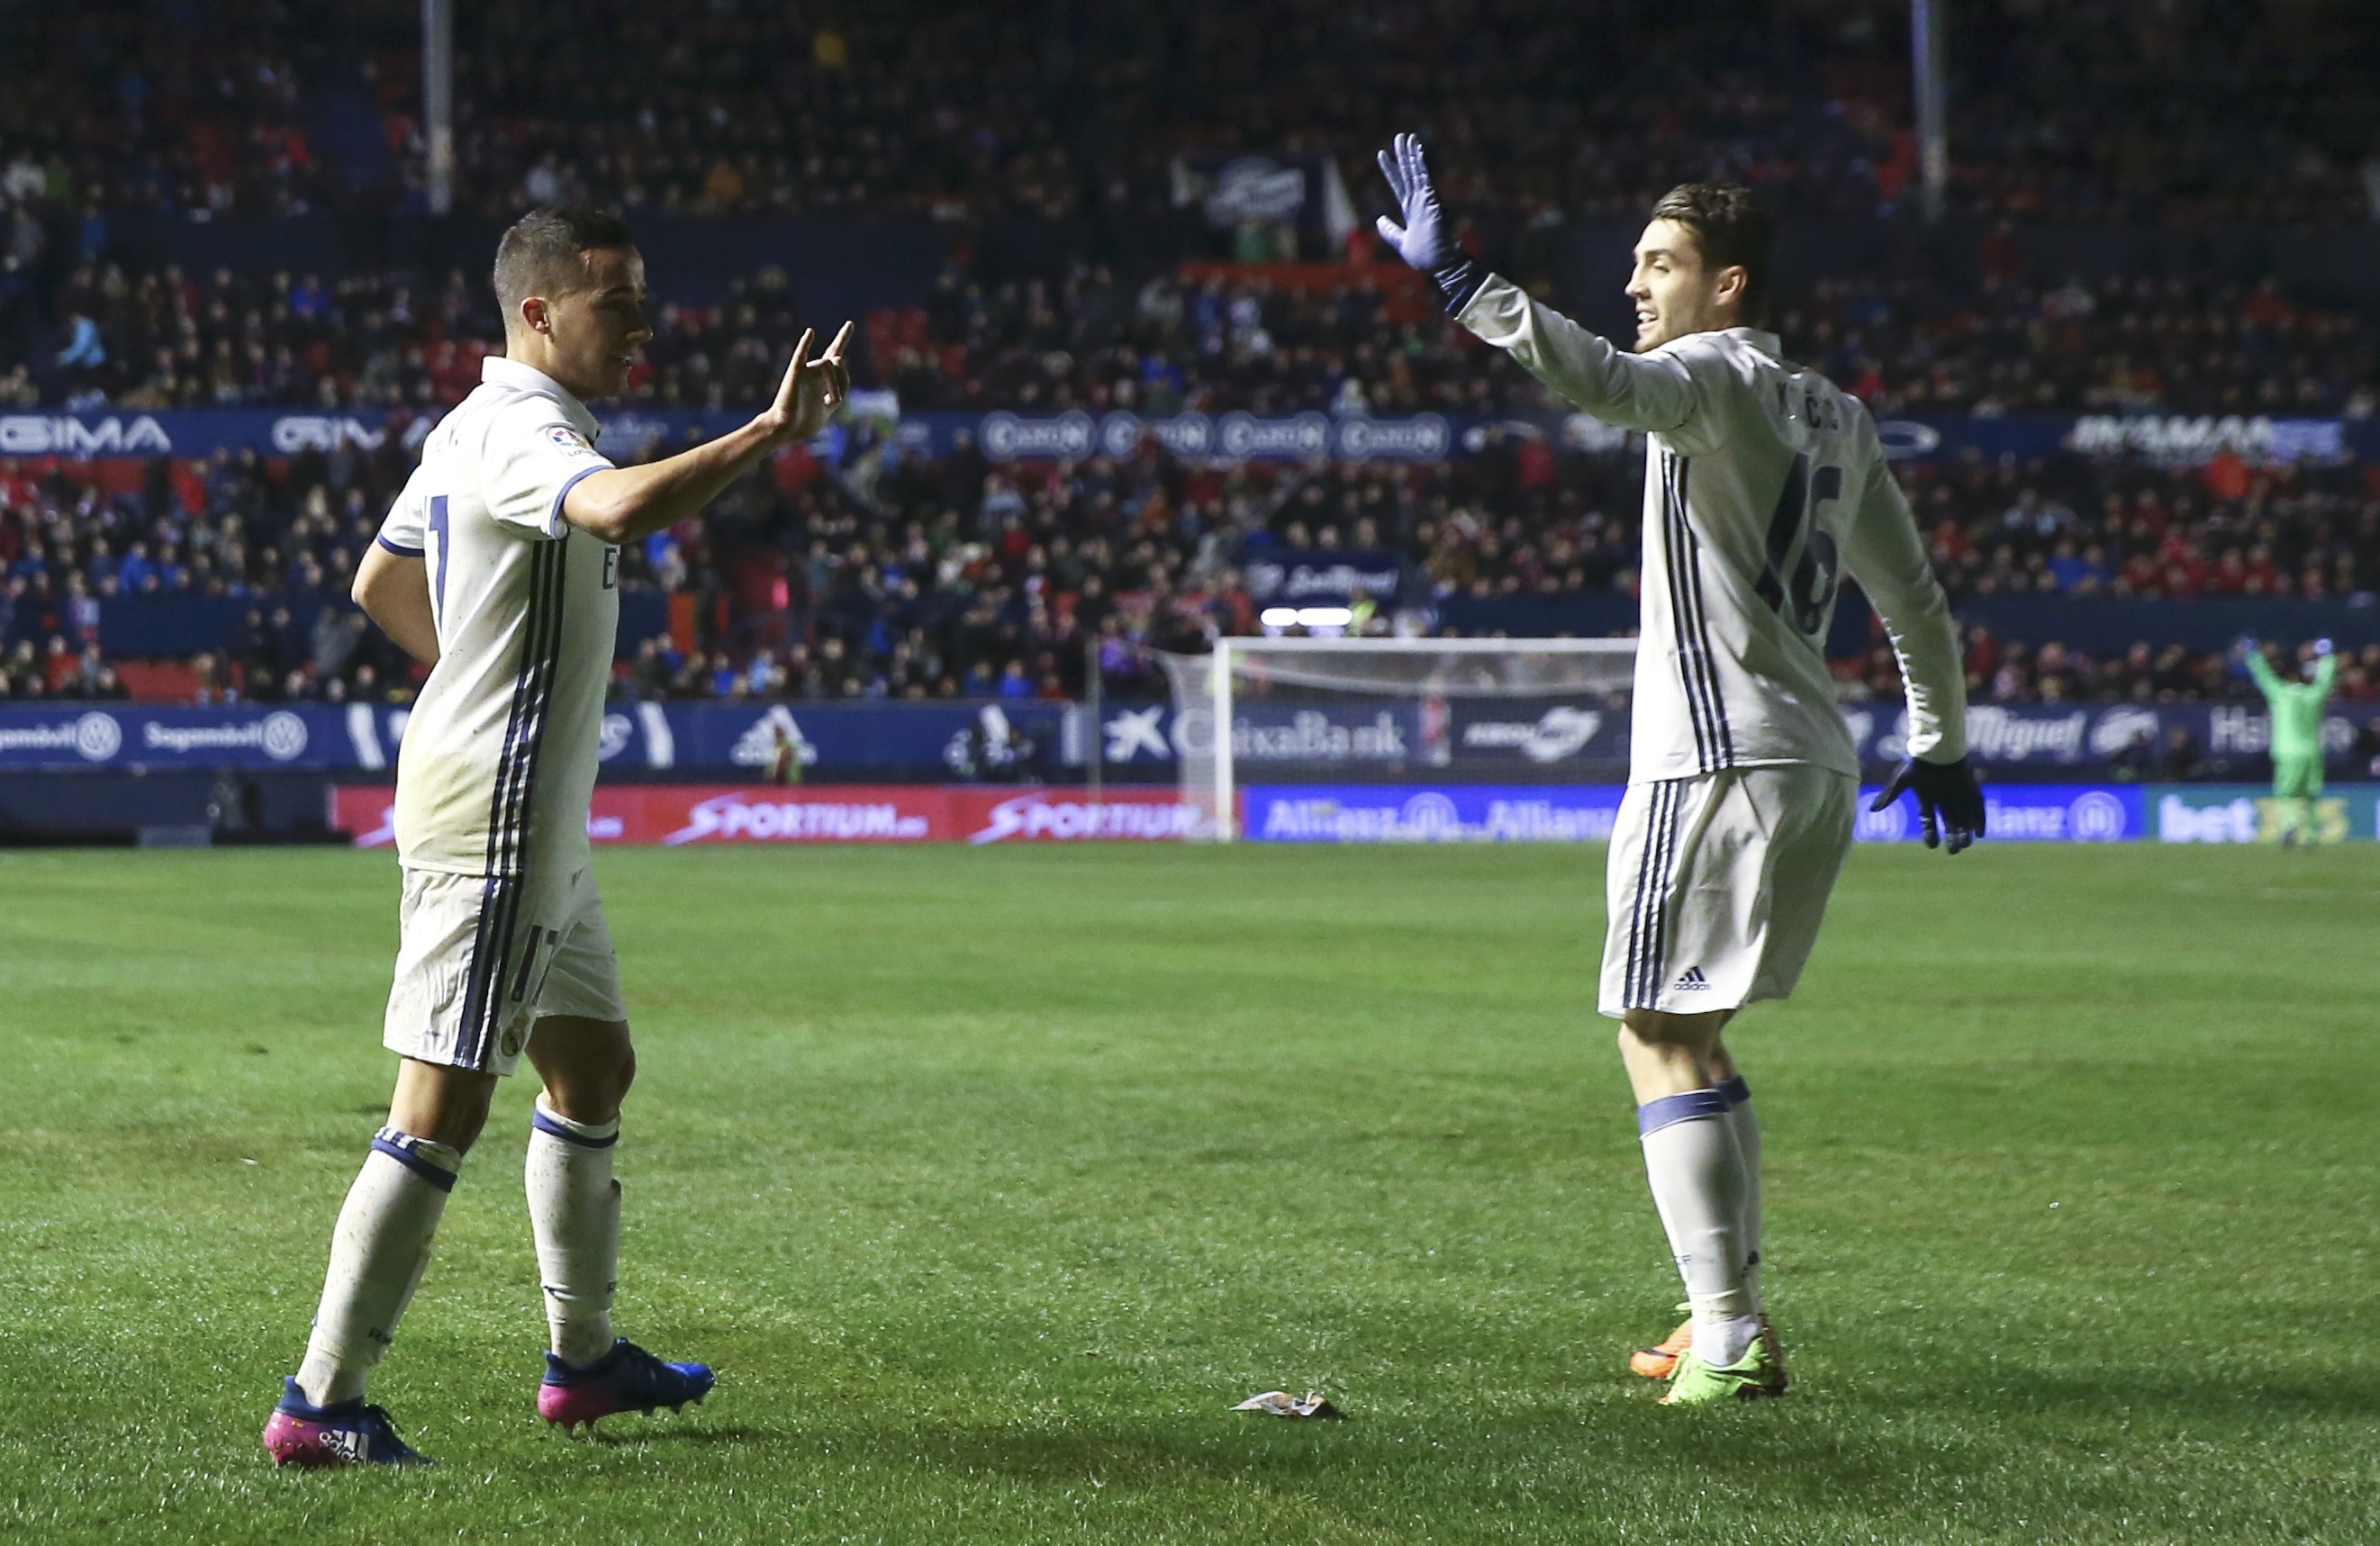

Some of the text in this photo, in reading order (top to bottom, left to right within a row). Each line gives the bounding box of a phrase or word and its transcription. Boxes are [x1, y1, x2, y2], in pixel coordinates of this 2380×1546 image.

[1753, 452, 1843, 636] 16
[602, 547, 618, 590] E
[1170, 708, 1407, 760] CixaBank
[1263, 798, 1401, 840] Allianz
[1986, 799, 2066, 839] ianz
[1674, 981, 1712, 990] adidas
